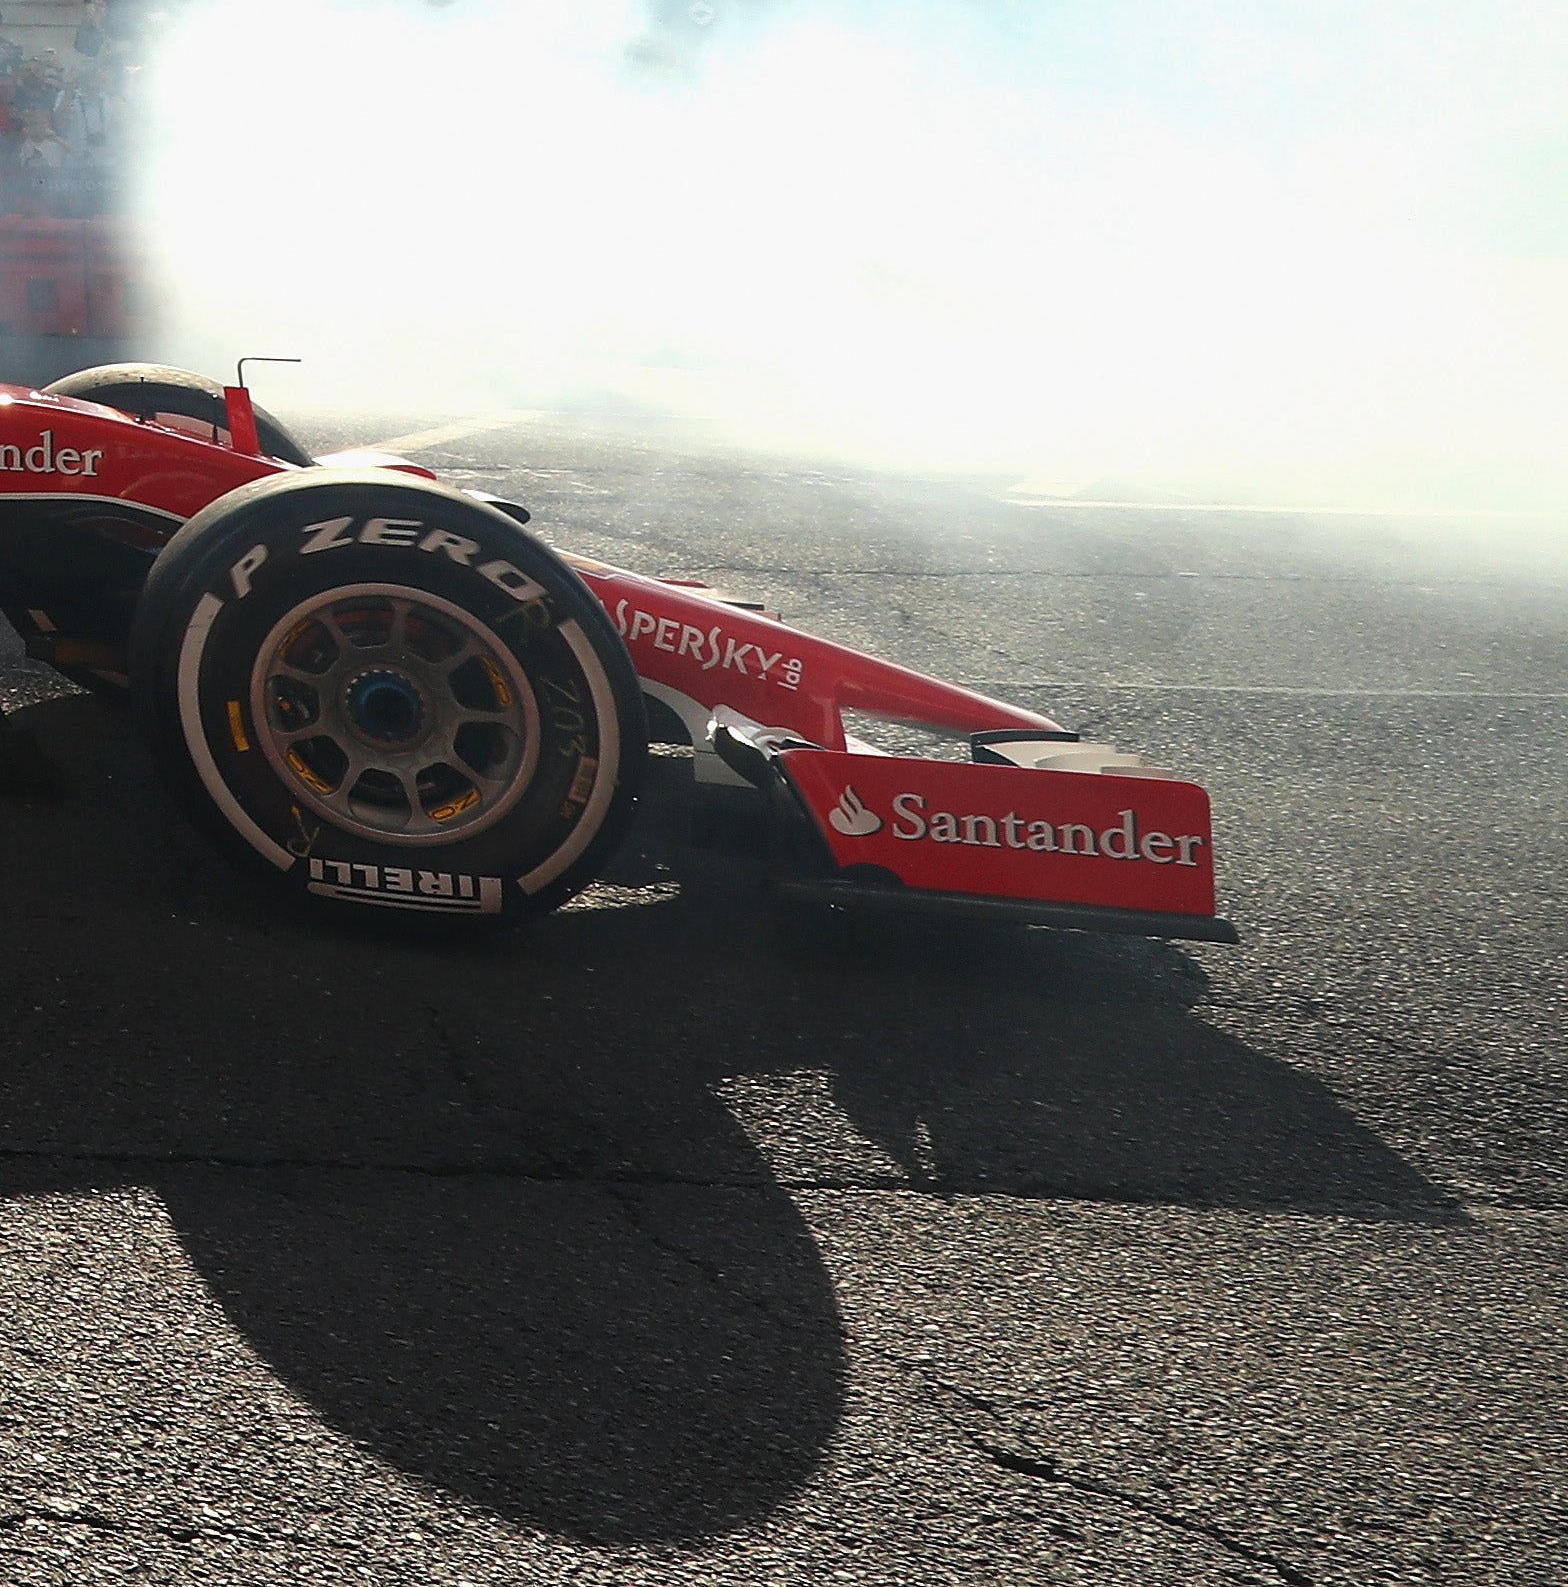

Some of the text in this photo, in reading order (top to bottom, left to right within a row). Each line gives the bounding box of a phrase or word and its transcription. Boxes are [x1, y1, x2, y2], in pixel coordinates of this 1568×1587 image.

[228, 516, 554, 604] P ZERO
[777, 658, 803, 692] lab
[892, 793, 1204, 867] Santander
[307, 857, 503, 913] PIRELLI
